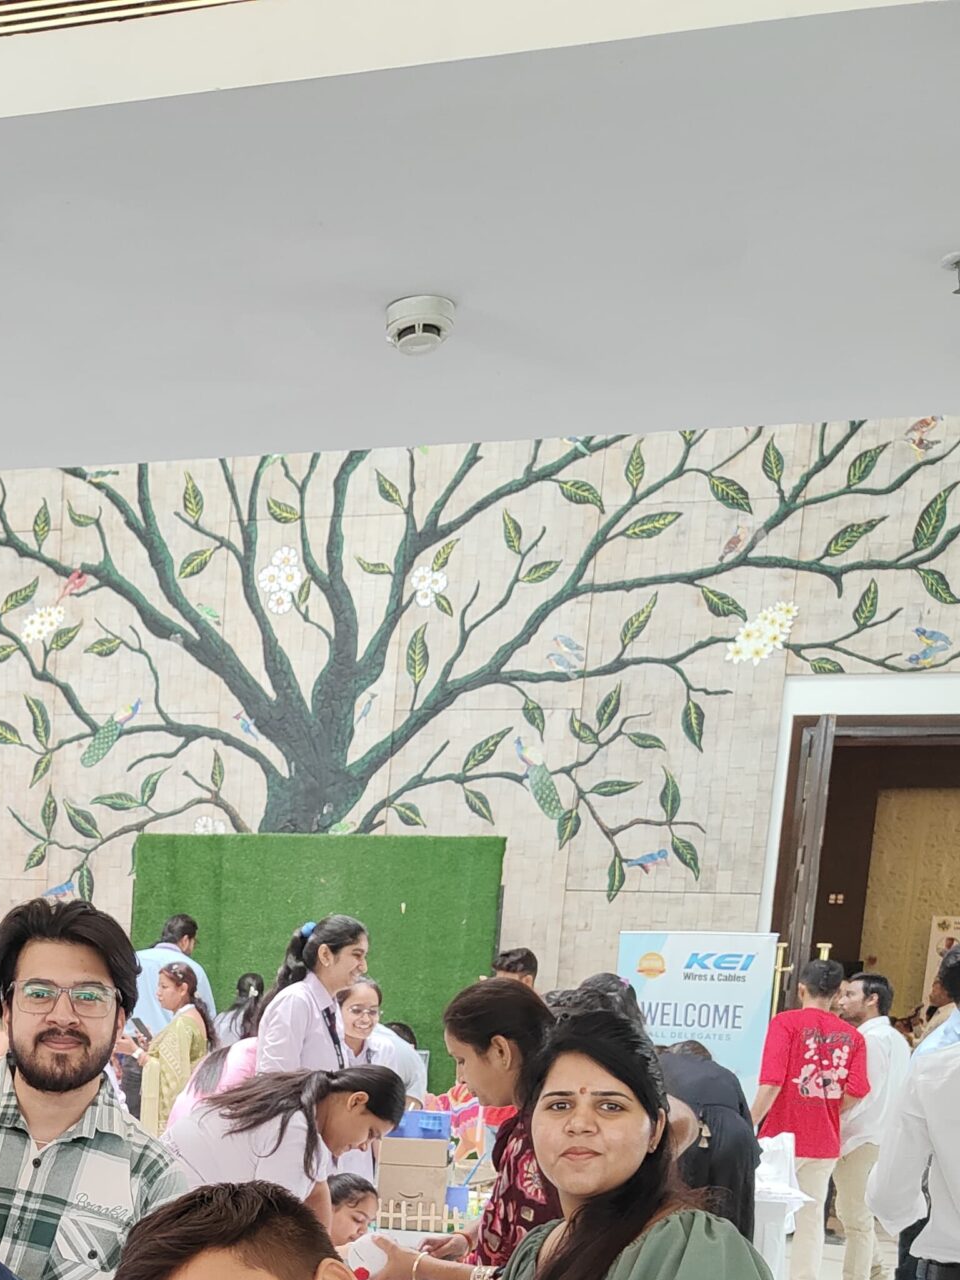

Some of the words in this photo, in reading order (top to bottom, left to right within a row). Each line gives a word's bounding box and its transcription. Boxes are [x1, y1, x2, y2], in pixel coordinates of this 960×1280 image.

[683, 952, 755, 971] KEI
[683, 972, 708, 981] Wires
[717, 973, 746, 983] Cables
[641, 1001, 743, 1029] WELCOME
[670, 1031, 732, 1041] DELEGATES
